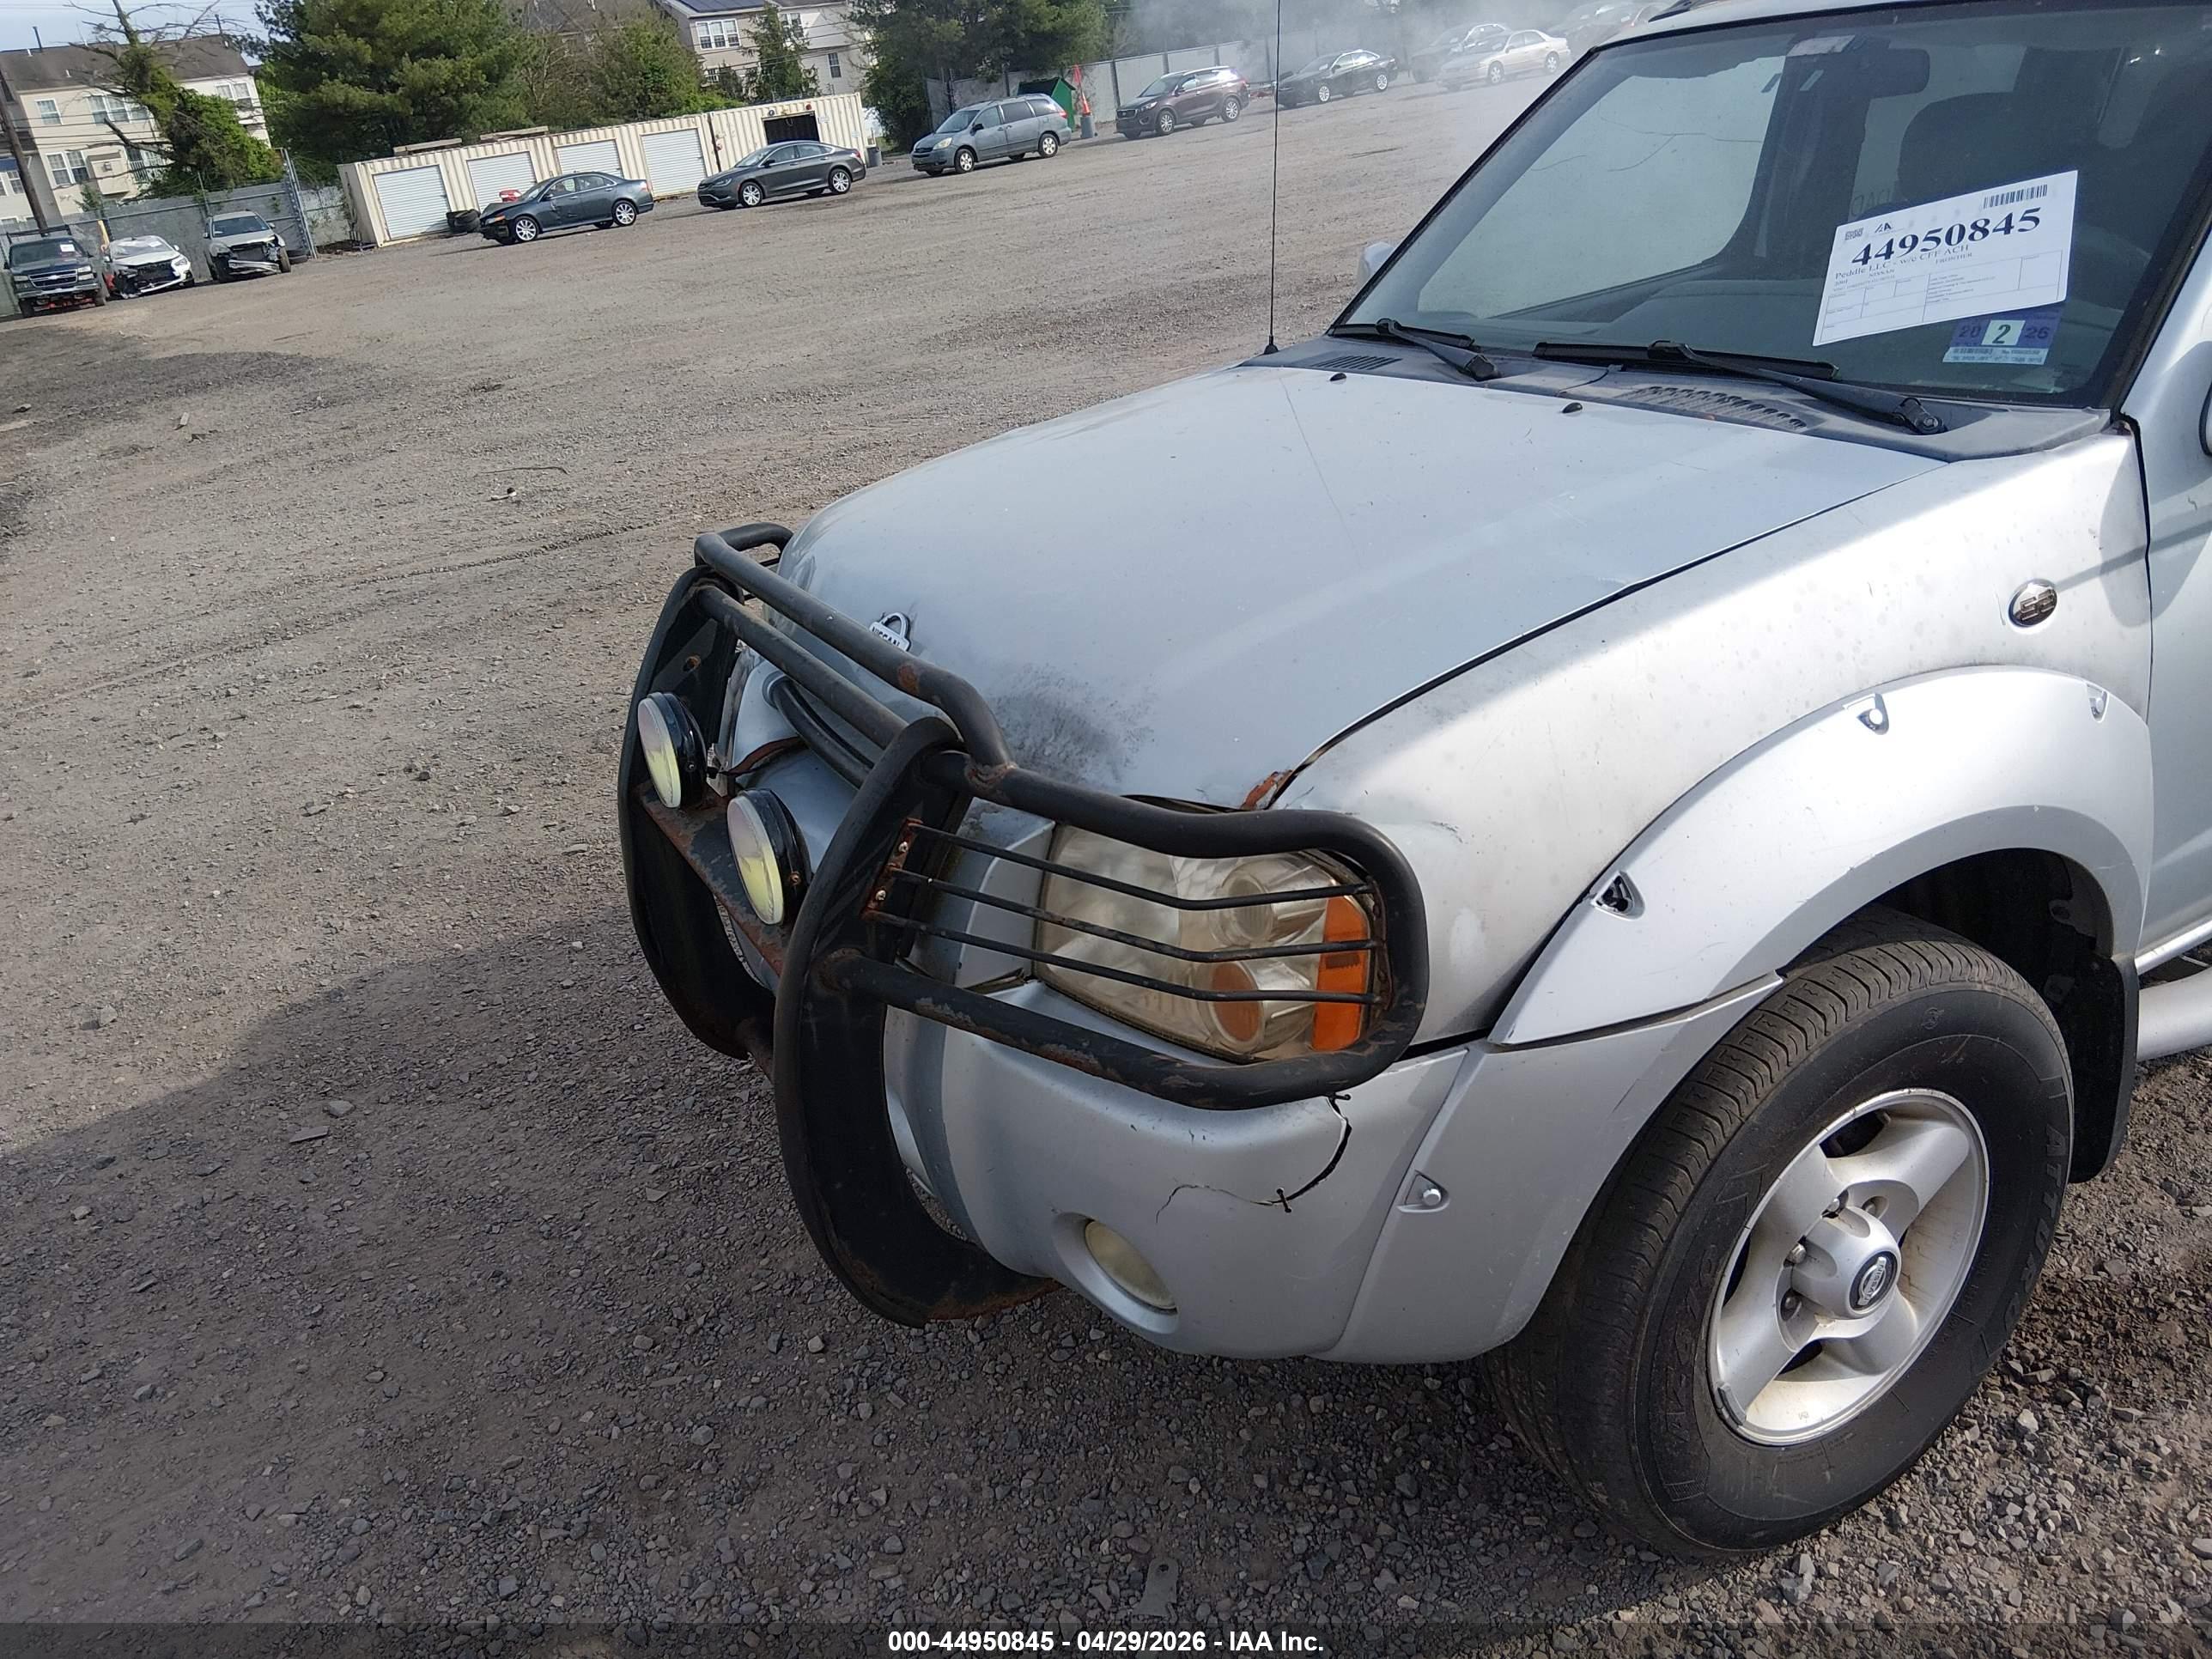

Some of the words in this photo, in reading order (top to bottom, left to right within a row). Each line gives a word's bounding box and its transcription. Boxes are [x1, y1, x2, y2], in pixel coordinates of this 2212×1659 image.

[1851, 207, 2042, 265] 44950845
[1835, 268, 1866, 280] Peddle
[1869, 261, 1890, 272] LLC
[1992, 324, 2011, 344] 2
[2003, 1122, 2070, 1334] ATTURO
[1864, 1263, 1885, 1301] NISSAN
